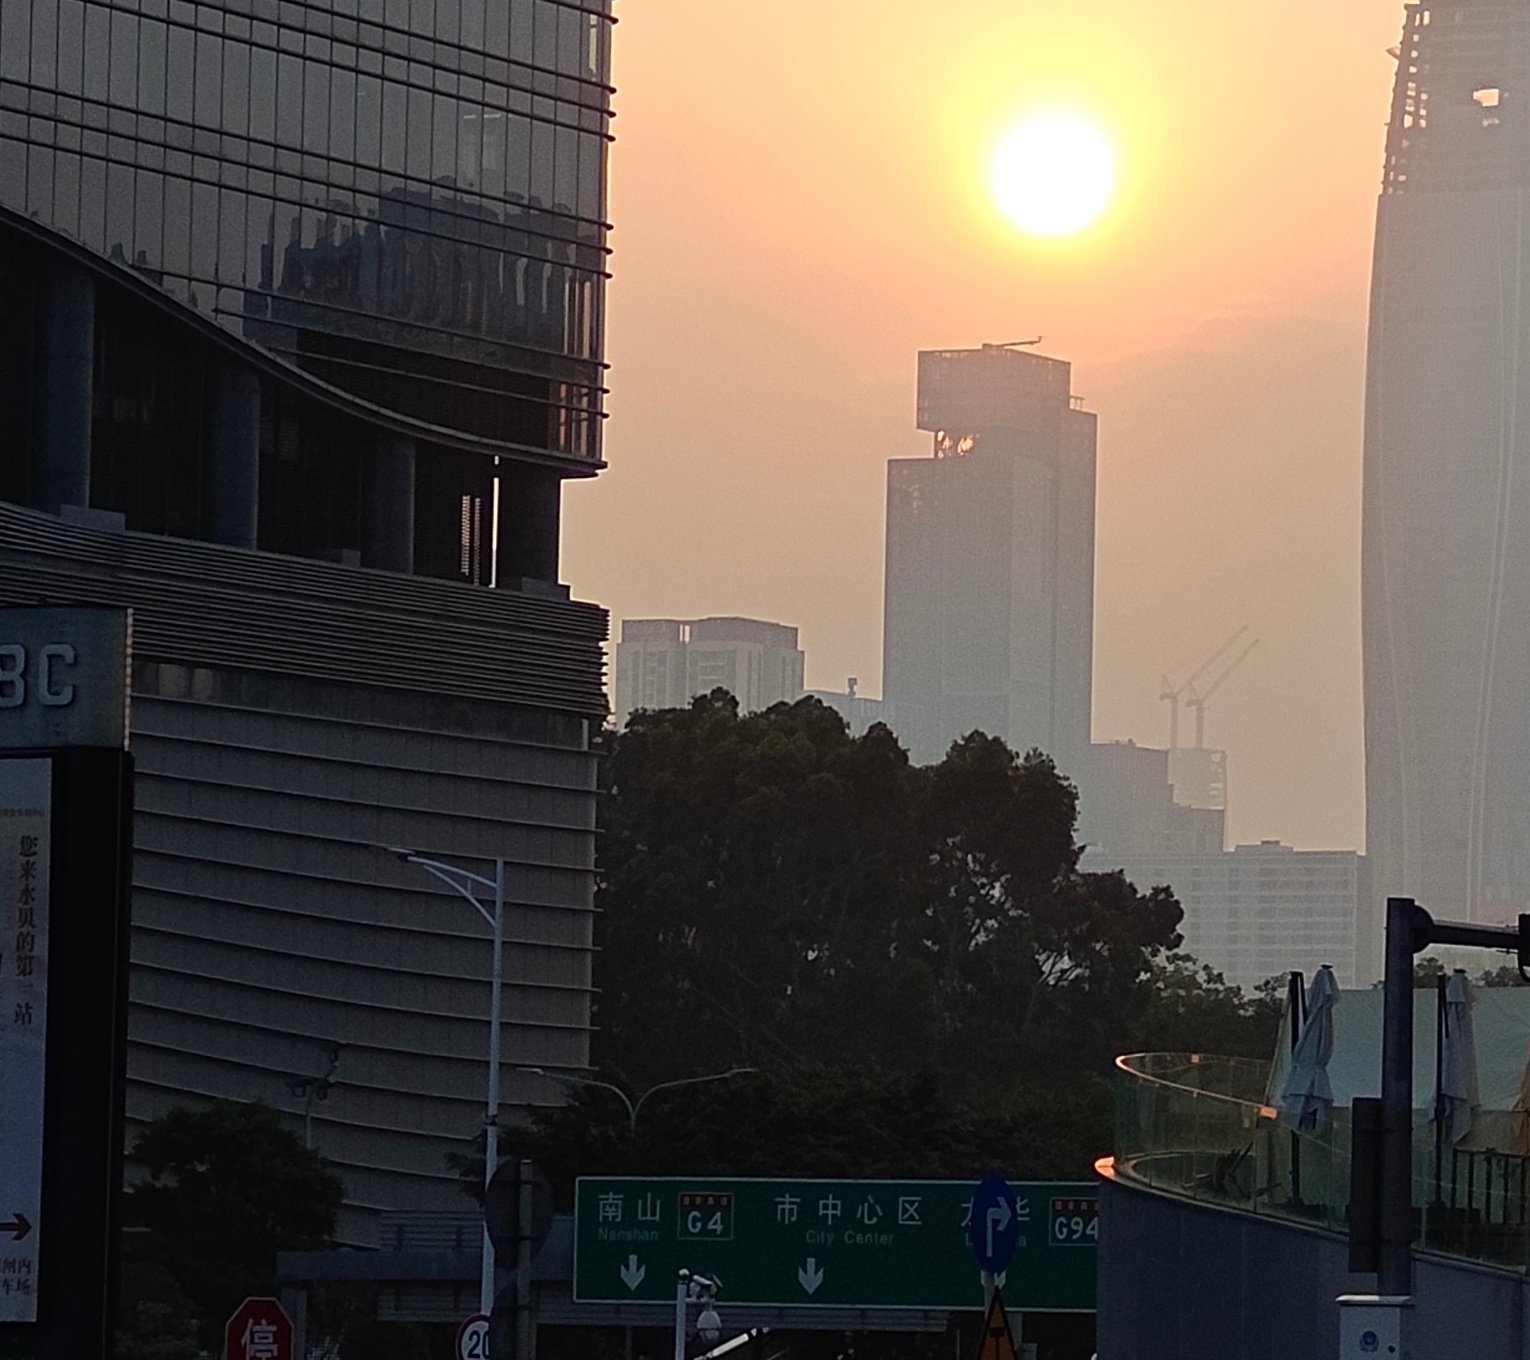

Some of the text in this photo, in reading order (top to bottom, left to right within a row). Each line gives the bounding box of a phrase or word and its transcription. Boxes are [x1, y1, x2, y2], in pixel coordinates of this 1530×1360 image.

[13, 834, 39, 1027] 您来水贝的第一站
[597, 1191, 661, 1223] 南山
[774, 1193, 923, 1226] 市中心区
[598, 1227, 659, 1242] Nanshan
[687, 1210, 724, 1235] G4
[1054, 1215, 1099, 1241] G94
[805, 1229, 895, 1247] City Center
[467, 1329, 491, 1360] 20
